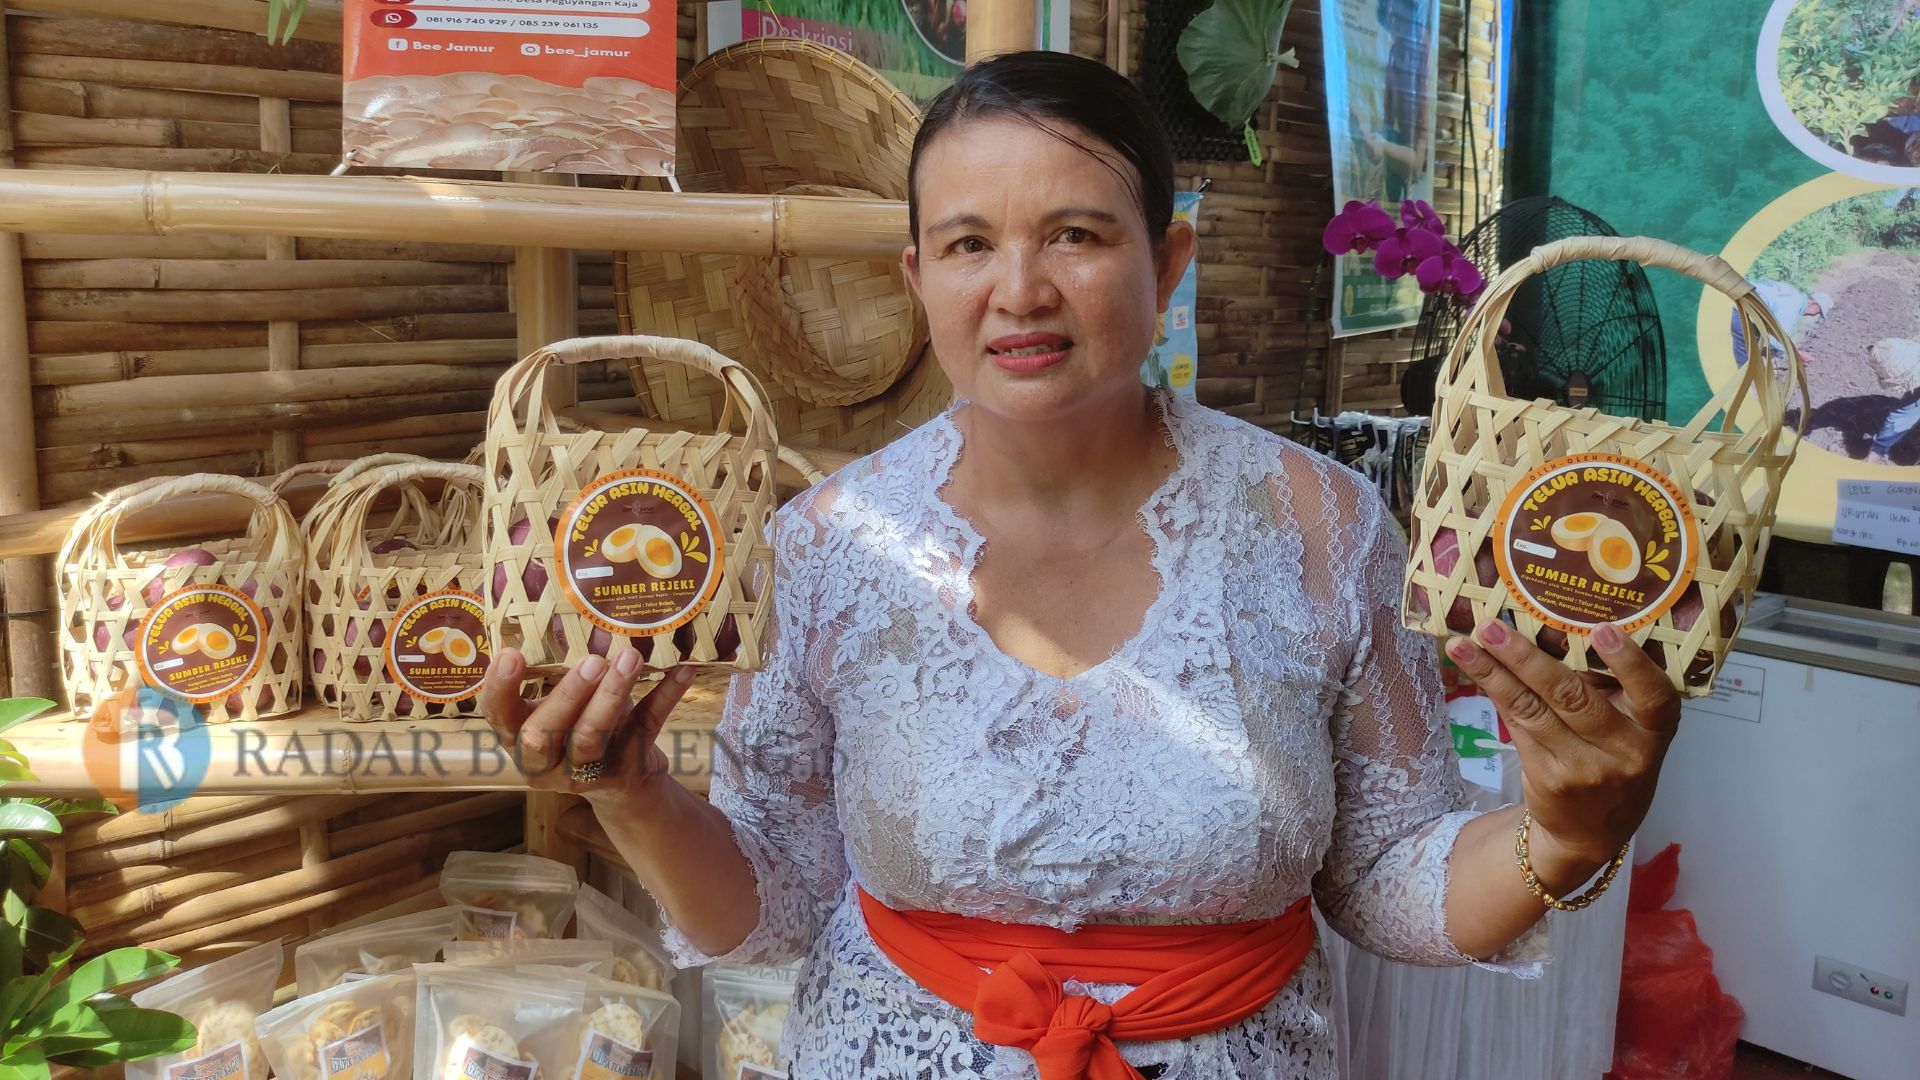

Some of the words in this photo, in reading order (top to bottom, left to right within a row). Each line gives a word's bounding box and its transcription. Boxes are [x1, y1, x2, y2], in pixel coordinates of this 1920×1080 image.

[426, 16, 443, 24] 081
[488, 18, 508, 26] 929
[762, 16, 853, 50] Deskripsi
[413, 41, 442, 51] Bee
[445, 42, 496, 53] Jamur
[545, 45, 631, 58] bee_jamur
[623, 470, 649, 478] KHAS
[656, 472, 703, 504] DENPASAR
[1607, 455, 1639, 468] KHAS
[1646, 467, 1690, 516] DENPASAR
[571, 494, 609, 543] TELUR
[609, 481, 650, 501] ASIN
[652, 484, 702, 532] HERBAL
[1523, 470, 1579, 511] TELUR
[1583, 467, 1634, 487] ASIN
[1633, 480, 1679, 544] HERBAL
[594, 582, 647, 597] SUMBER
[650, 579, 696, 592] REJEKI
[1525, 563, 1588, 589] SUMBER
[1591, 581, 1645, 603] REJEKI
[683, 594, 708, 621] LEZAT
[1536, 595, 1558, 607] Garam,
[1558, 601, 1609, 620] Rempah-Rempah,
[1544, 589, 1574, 604] Komposisi
[1578, 598, 1594, 608] Telur
[1594, 602, 1614, 614] Bebek,
[148, 607, 175, 646] TELUR
[173, 593, 206, 611] ASIN
[207, 593, 249, 622] HERBAL
[398, 605, 429, 637] TELUR
[429, 598, 460, 611] ASIN
[169, 664, 211, 681] SUMBER
[213, 654, 248, 670] REJEKI
[409, 667, 448, 675] SUMBER
